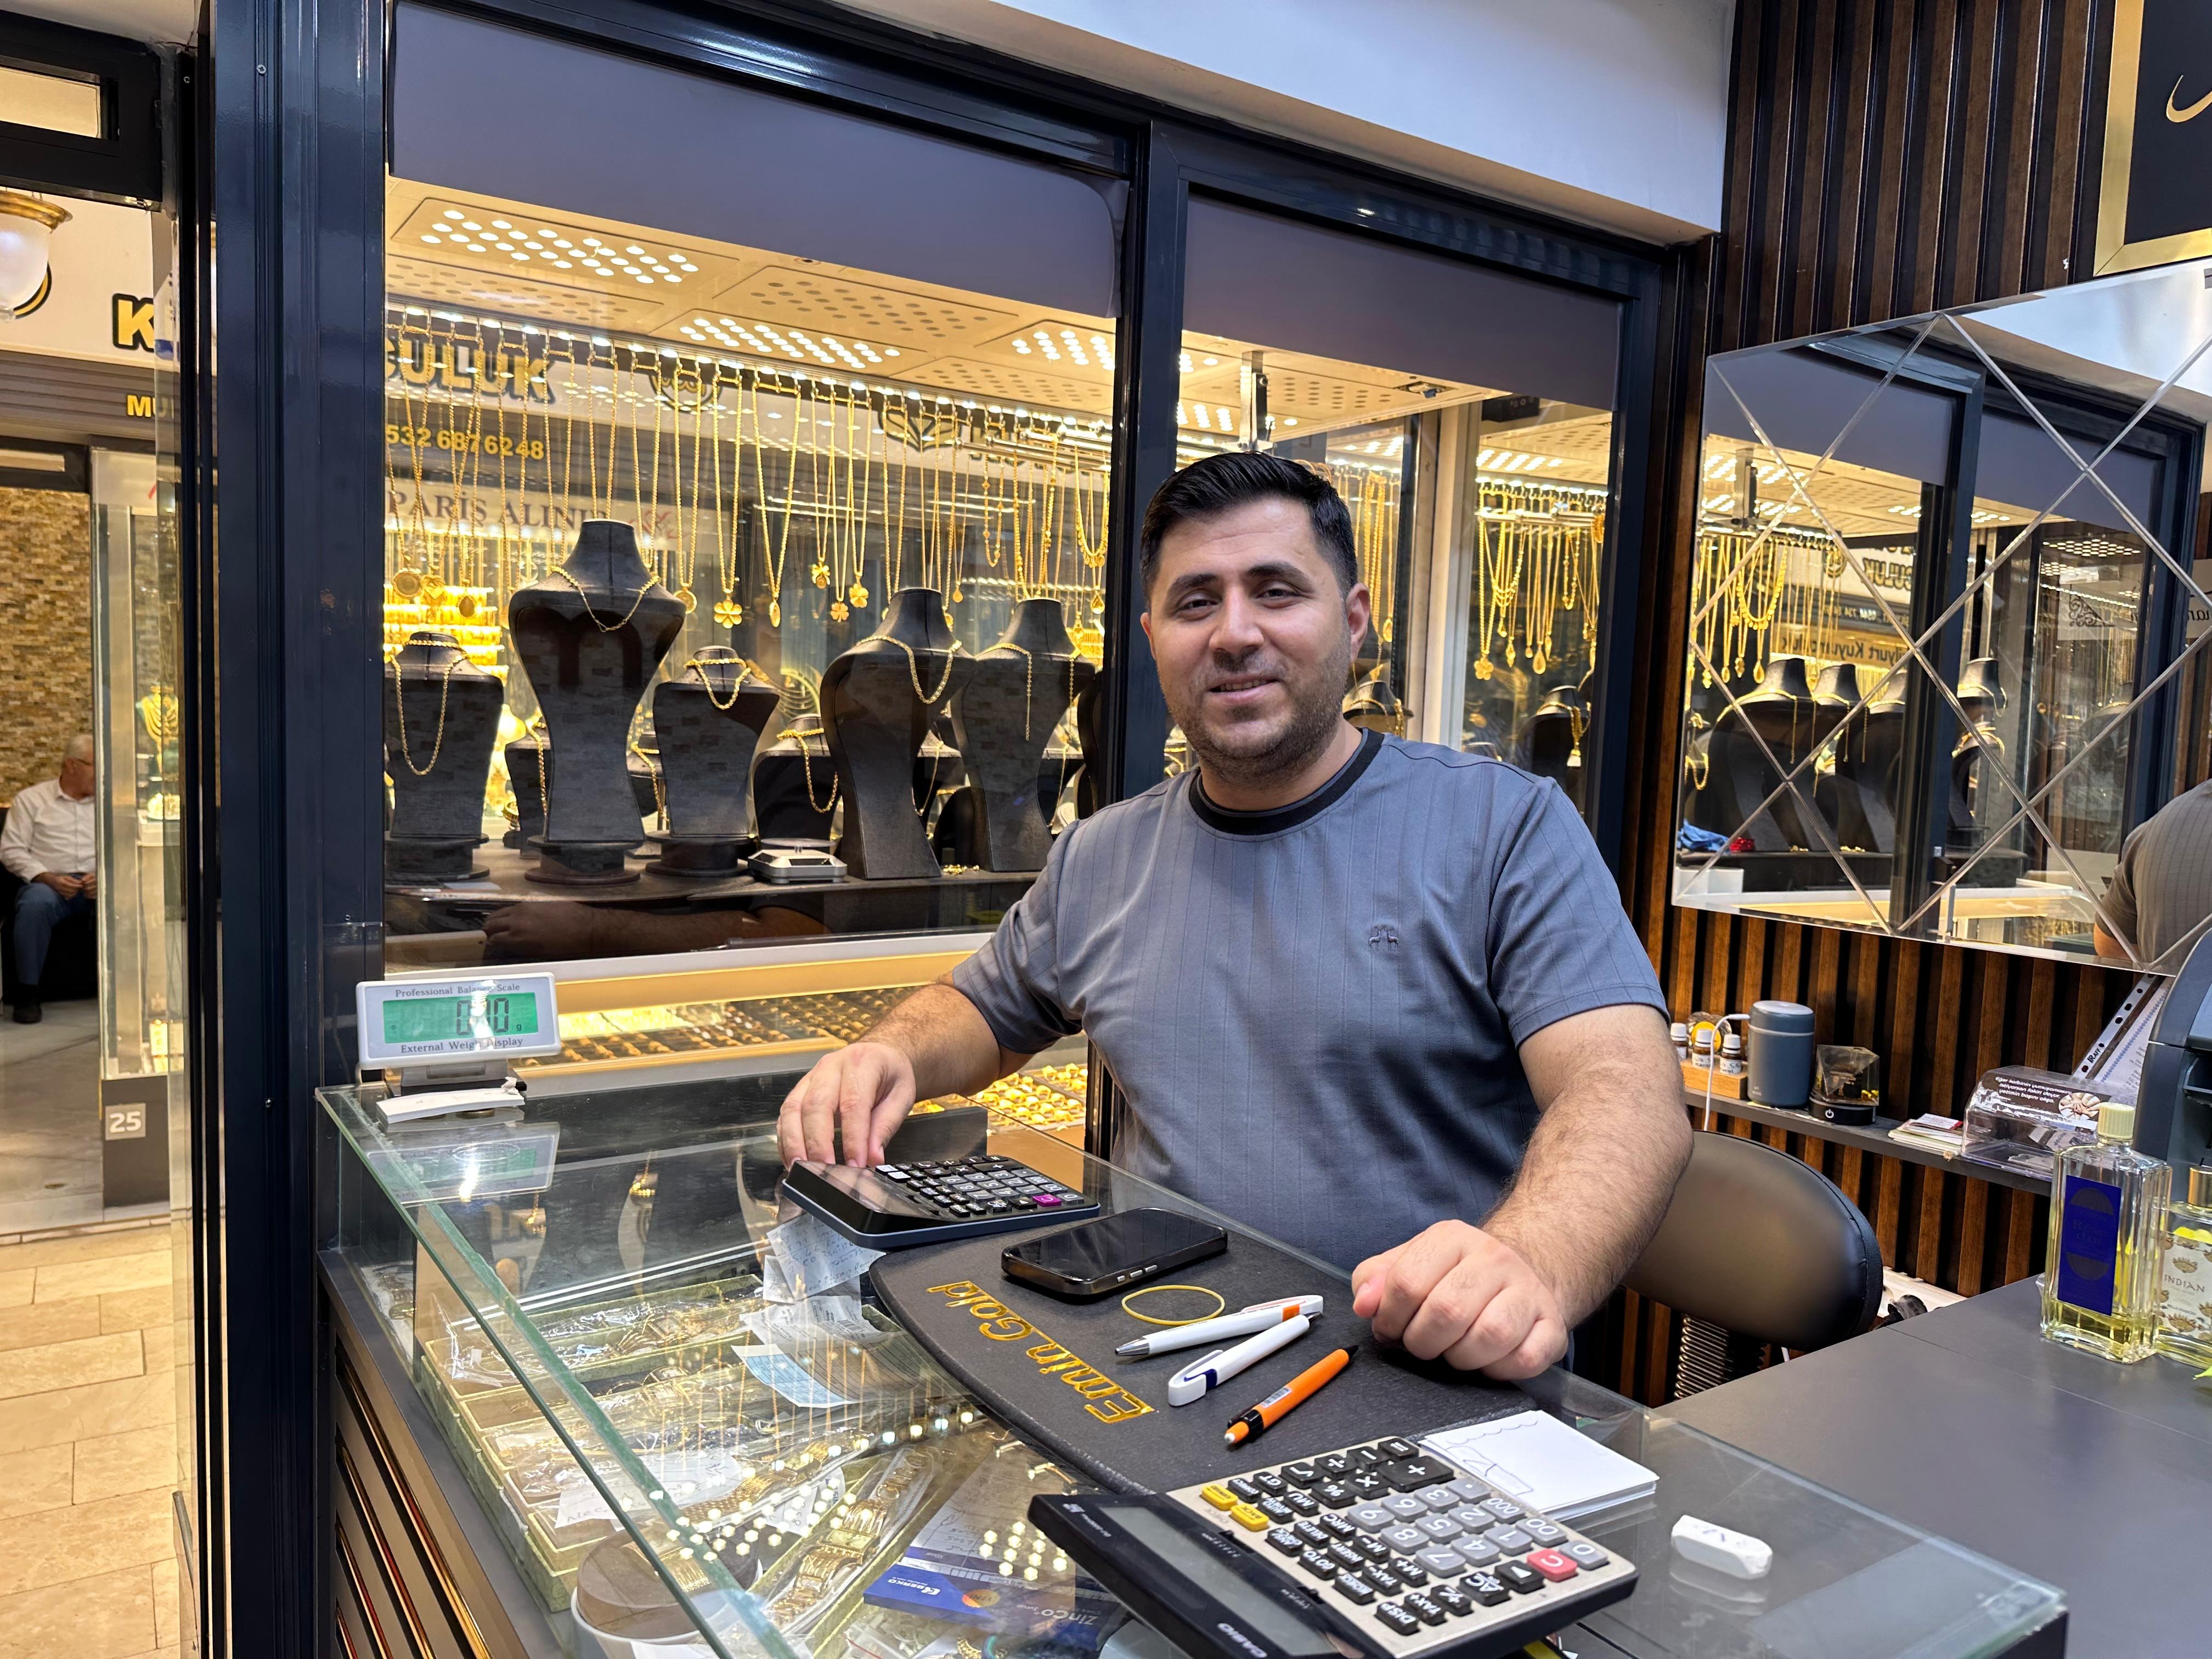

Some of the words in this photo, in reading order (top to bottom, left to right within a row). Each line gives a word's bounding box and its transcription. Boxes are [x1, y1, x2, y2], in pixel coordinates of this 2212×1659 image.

[395, 987, 453, 997] Professional
[496, 984, 521, 992] Scale
[400, 1043, 444, 1054] External
[110, 1111, 142, 1133] 25
[2164, 1274, 2206, 1293] INDIAN
[926, 1279, 1034, 1341] Gold
[1026, 1342, 1155, 1424] Emin
[1259, 1475, 1282, 1486] GT
[1426, 1488, 1449, 1500] 3
[1394, 1498, 1417, 1509] 6
[1486, 1498, 1520, 1514] 000
[1359, 1510, 1384, 1520] 9
[1460, 1508, 1487, 1521] 2
[1323, 1514, 1356, 1532] MRC
[1426, 1518, 1452, 1531] 5
[1525, 1519, 1559, 1535] 00
[1393, 1528, 1419, 1541] 8
[1463, 1539, 1486, 1550] 4
[1571, 1544, 1596, 1555] 0
[1539, 1554, 1564, 1567] C
[887, 1578, 925, 1589] BERKO
[1380, 1602, 1417, 1624] DISP
[1217, 1622, 1267, 1658] CASIO
